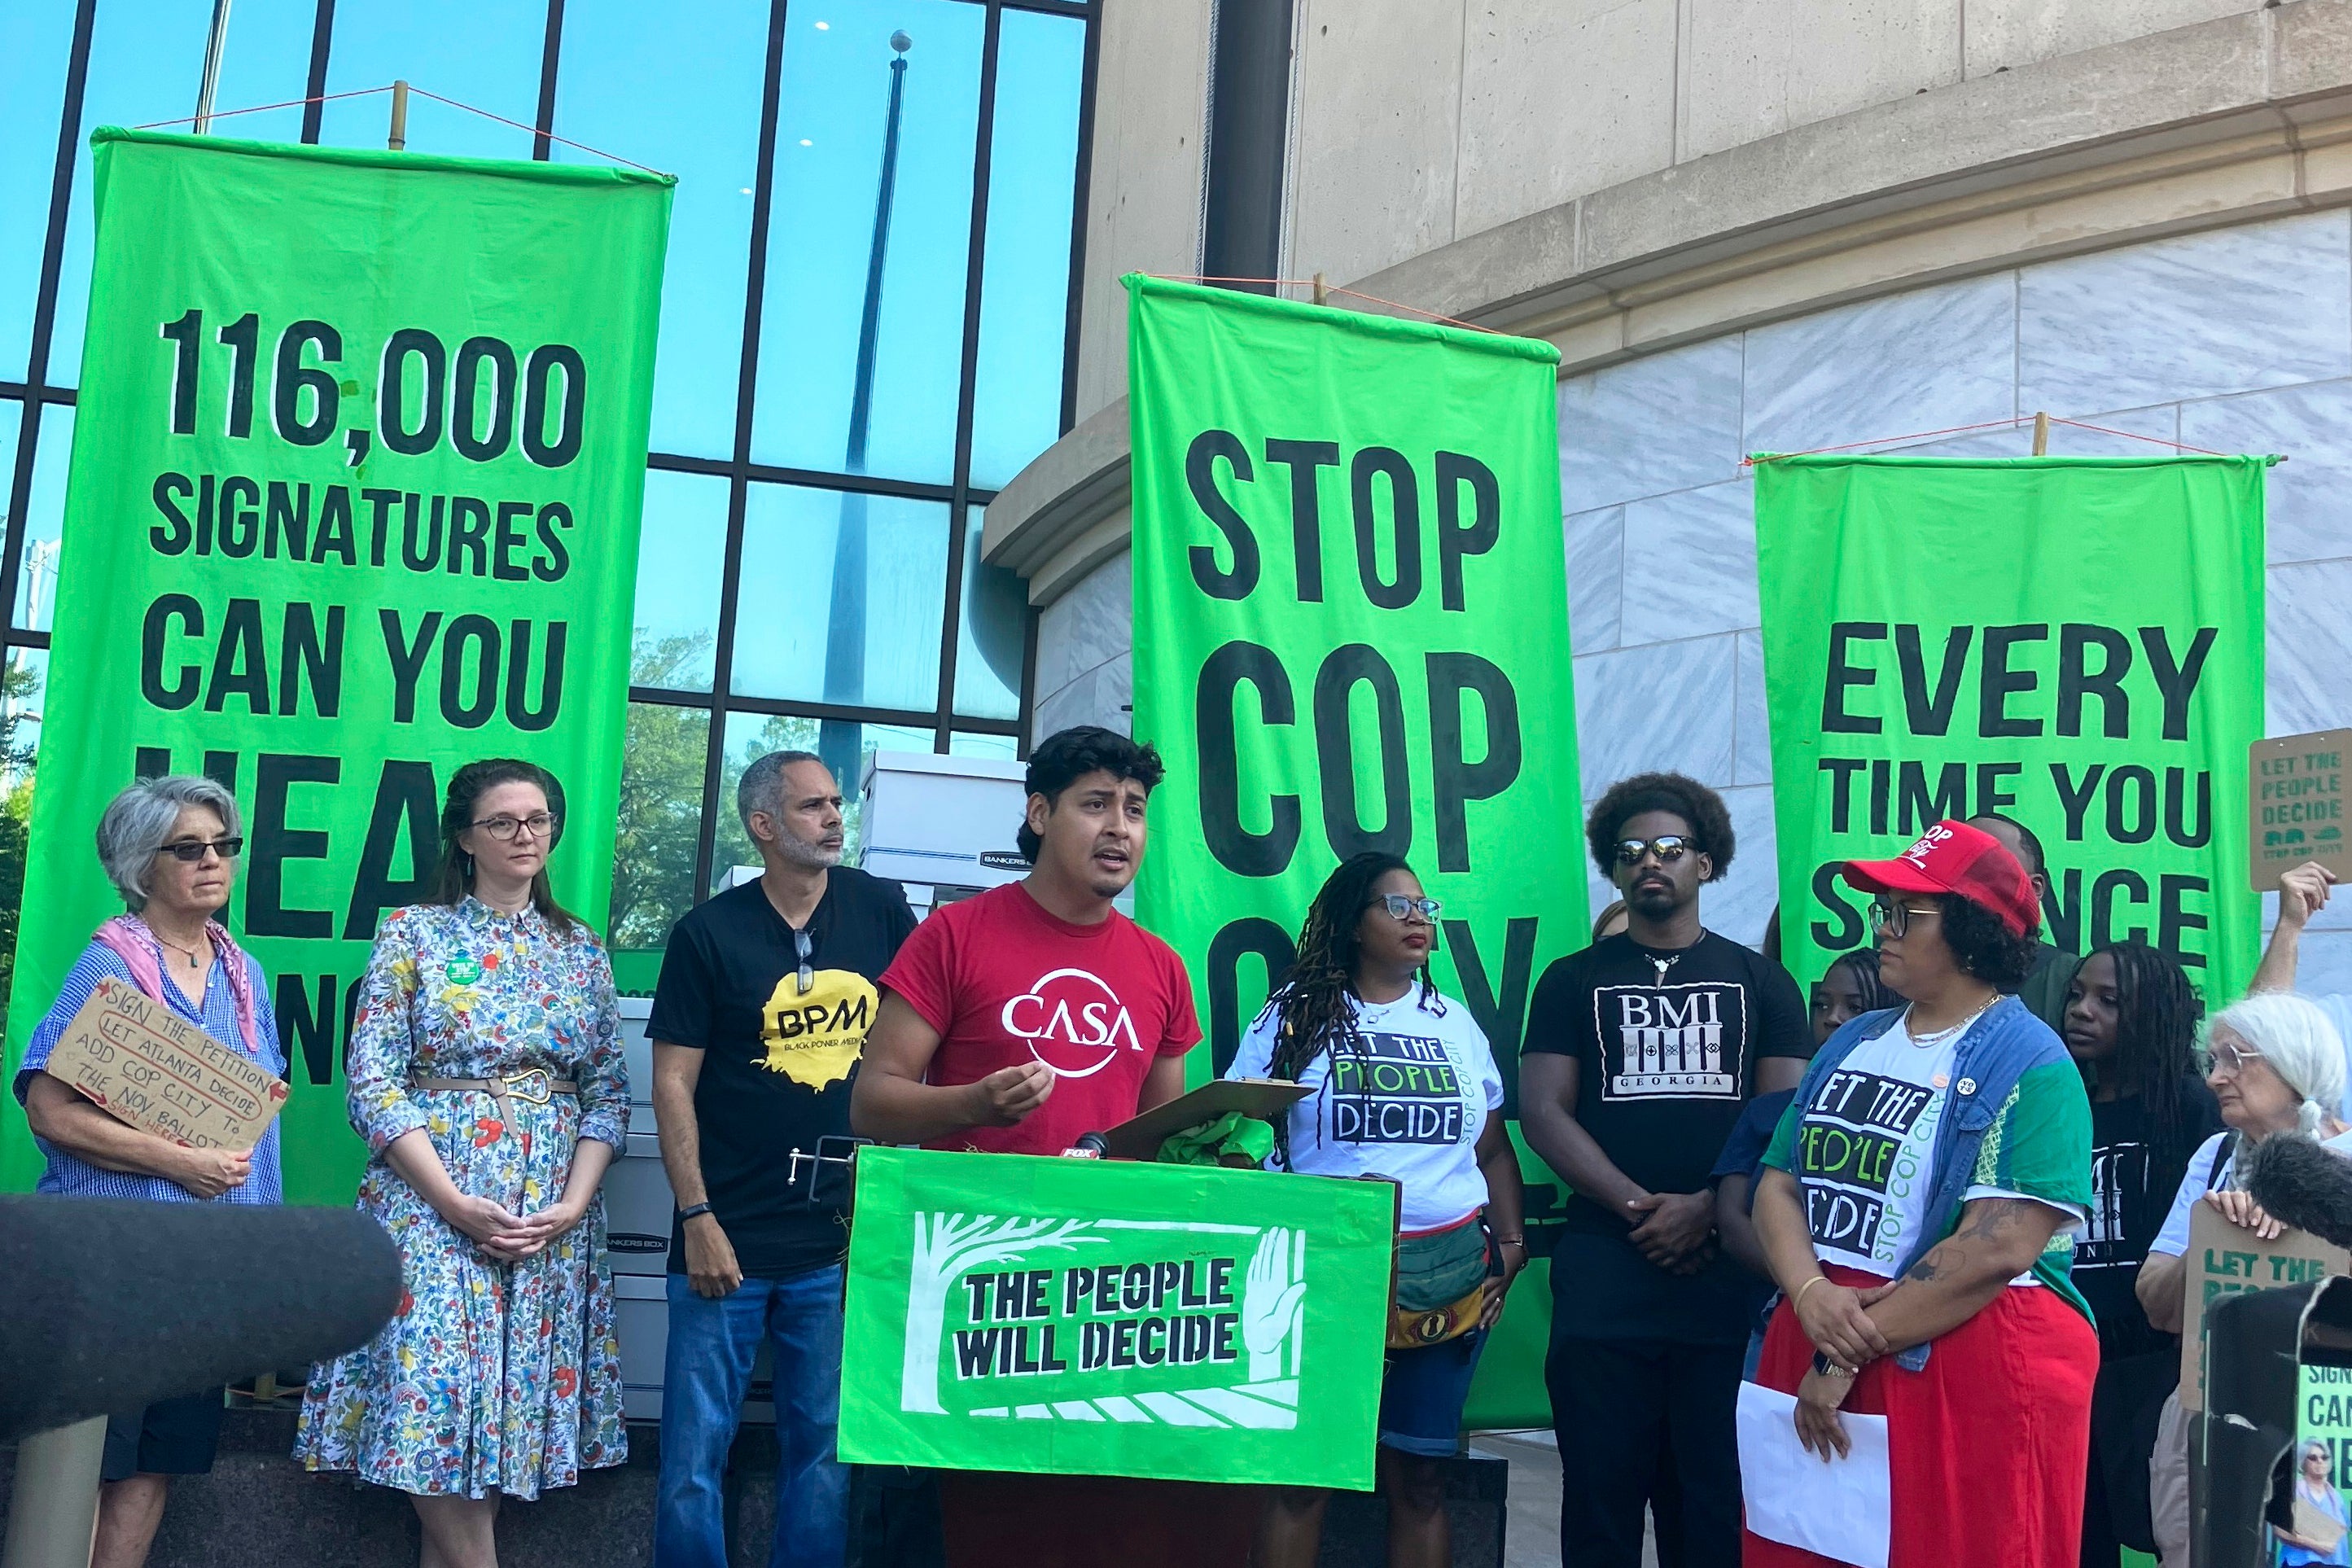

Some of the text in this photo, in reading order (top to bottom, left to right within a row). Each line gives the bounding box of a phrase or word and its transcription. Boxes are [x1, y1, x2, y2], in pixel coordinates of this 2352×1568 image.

[160, 309, 586, 467] 116,000
[150, 472, 573, 582] SIGNATURES
[1185, 429, 1500, 611] STOP
[142, 593, 567, 730] CAN YOU
[1821, 622, 2218, 740] EVERY
[1197, 640, 1522, 877] COP
[2261, 751, 2341, 776] LET THE
[2262, 774, 2341, 800] PEOPLE
[2050, 763, 2210, 848] YOU
[2262, 799, 2342, 826] DECIDE
[135, 747, 566, 940] EA
[984, 856, 1026, 865] BANKERS
[106, 983, 272, 1093] SIGN THE PETITION
[777, 994, 868, 1039] BPM
[1001, 994, 1144, 1051] CASA
[1618, 992, 1722, 1029] BMI
[76, 1033, 115, 1064] ADD
[123, 1060, 161, 1085] COP
[164, 1084, 212, 1119] CITY
[102, 1018, 256, 1115] LET ATLANTA DECIDE
[784, 1042, 809, 1051] BLACK
[811, 1039, 839, 1048] POWER
[1391, 1036, 1445, 1061] THE
[77, 1062, 114, 1093] THE
[157, 1111, 224, 1149] BALLOT
[1442, 1039, 1476, 1145] STOP COP CITY
[1620, 1076, 1722, 1087] GEORGIA
[1809, 1072, 1926, 1131] ET THE
[107, 1100, 177, 1141] SIGN HERE
[1063, 1149, 1094, 1158] FOX
[1338, 1103, 1458, 1140] DECIDE
[1875, 1093, 1945, 1264] STOP COP CITY
[962, 1258, 1235, 1324] THE PEOPLE
[2204, 1248, 2325, 1282] LET THE
[952, 1312, 1239, 1381] WILL DECIDE
